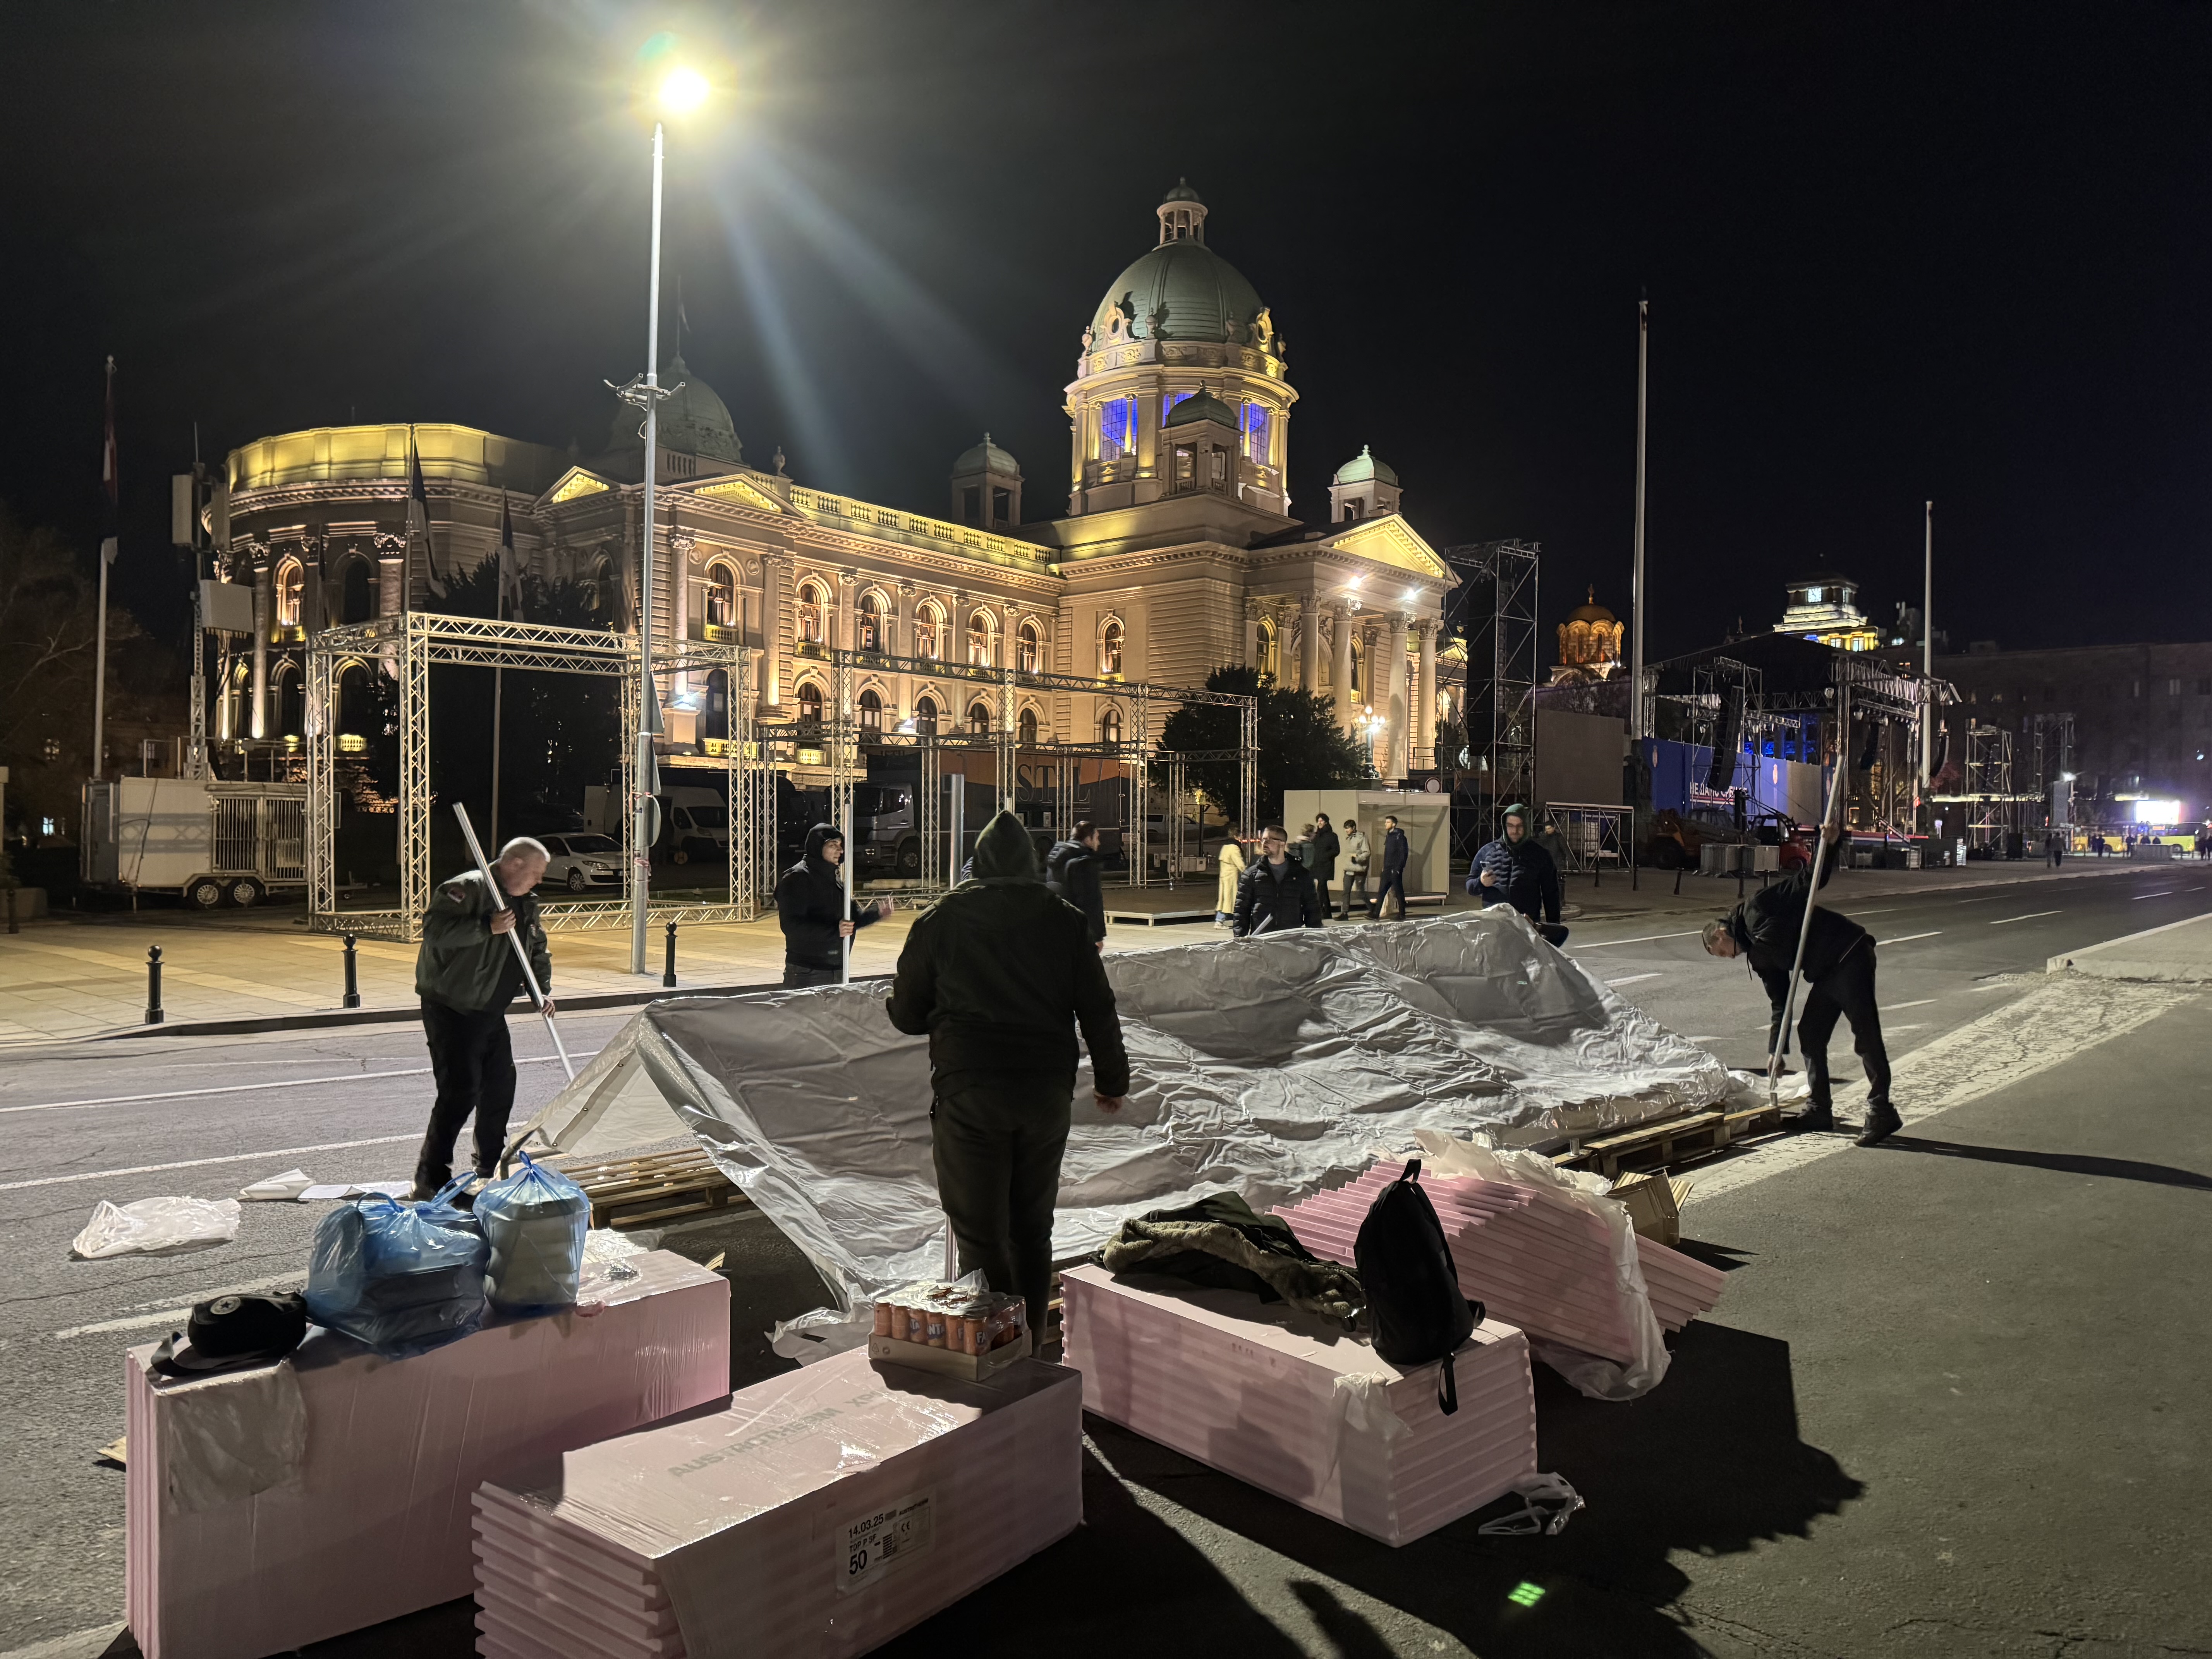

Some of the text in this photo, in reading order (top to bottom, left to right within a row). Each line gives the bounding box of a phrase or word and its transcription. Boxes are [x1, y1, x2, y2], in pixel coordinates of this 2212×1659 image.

[848, 1513, 884, 1538] 14.03.25
[849, 1542, 861, 1553] TOP
[869, 1534, 876, 1543] SF
[849, 1550, 867, 1575] 50
